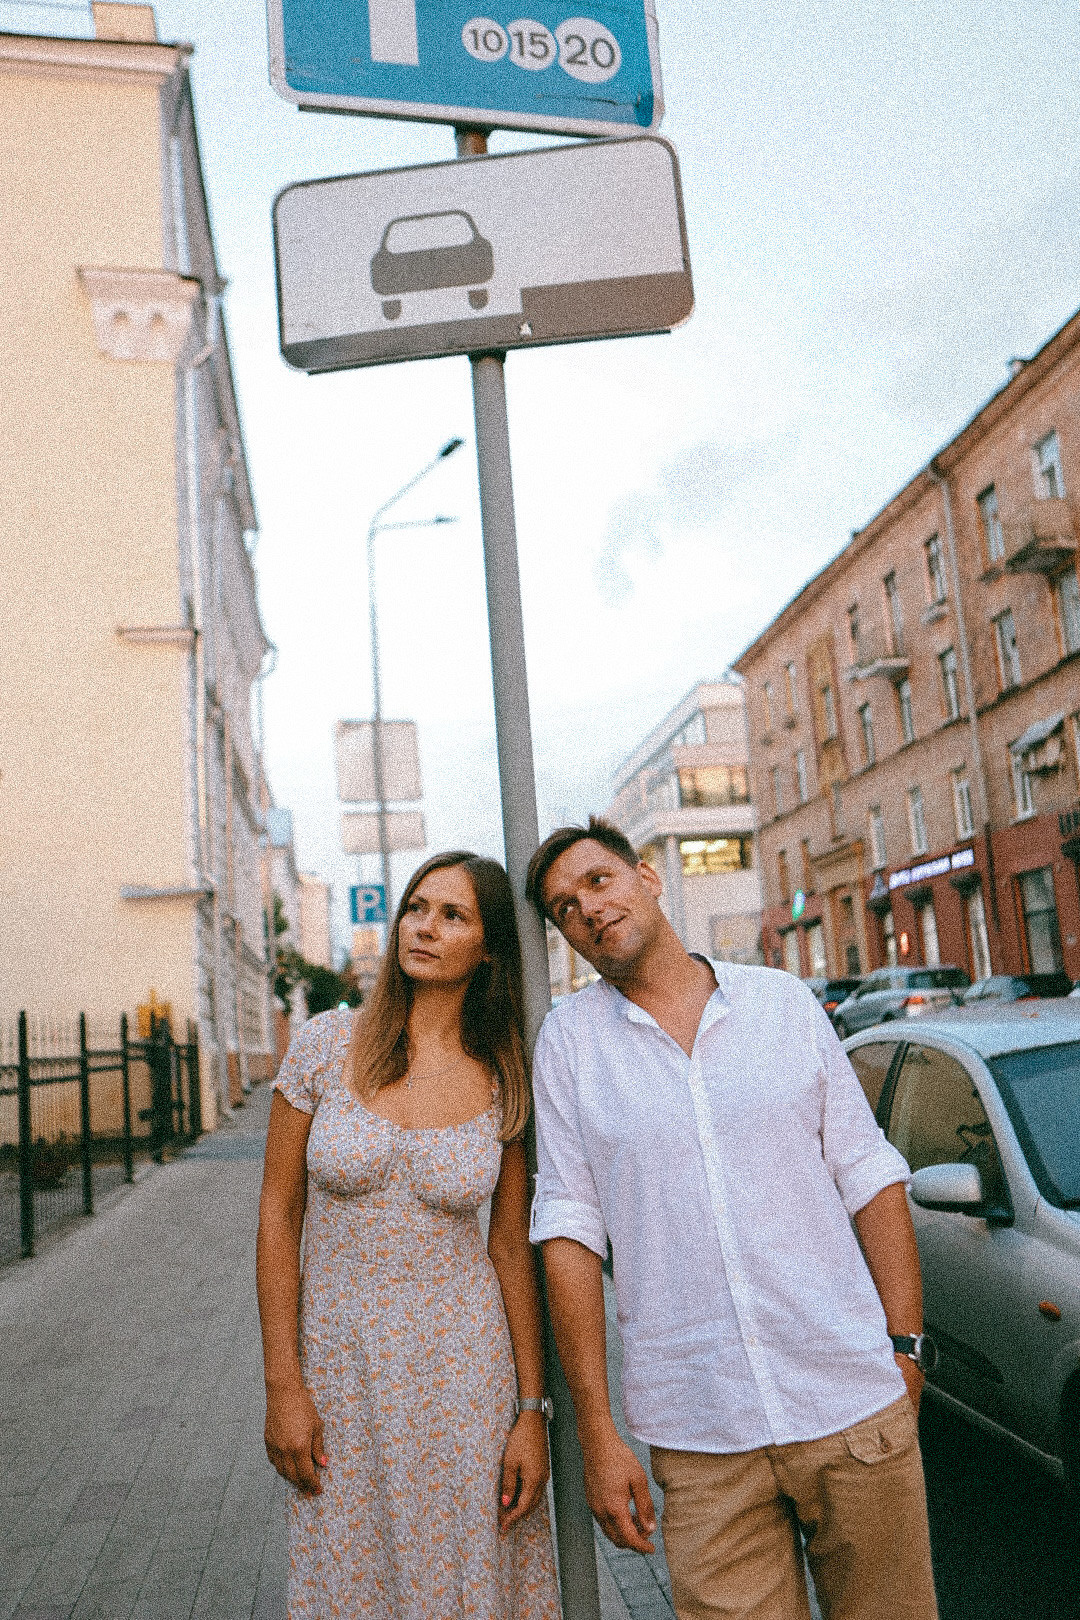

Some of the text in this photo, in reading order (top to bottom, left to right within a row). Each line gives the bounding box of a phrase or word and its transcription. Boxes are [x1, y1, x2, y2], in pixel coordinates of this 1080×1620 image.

[469, 29, 616, 69] 10 15 20
[356, 889, 380, 920] P
